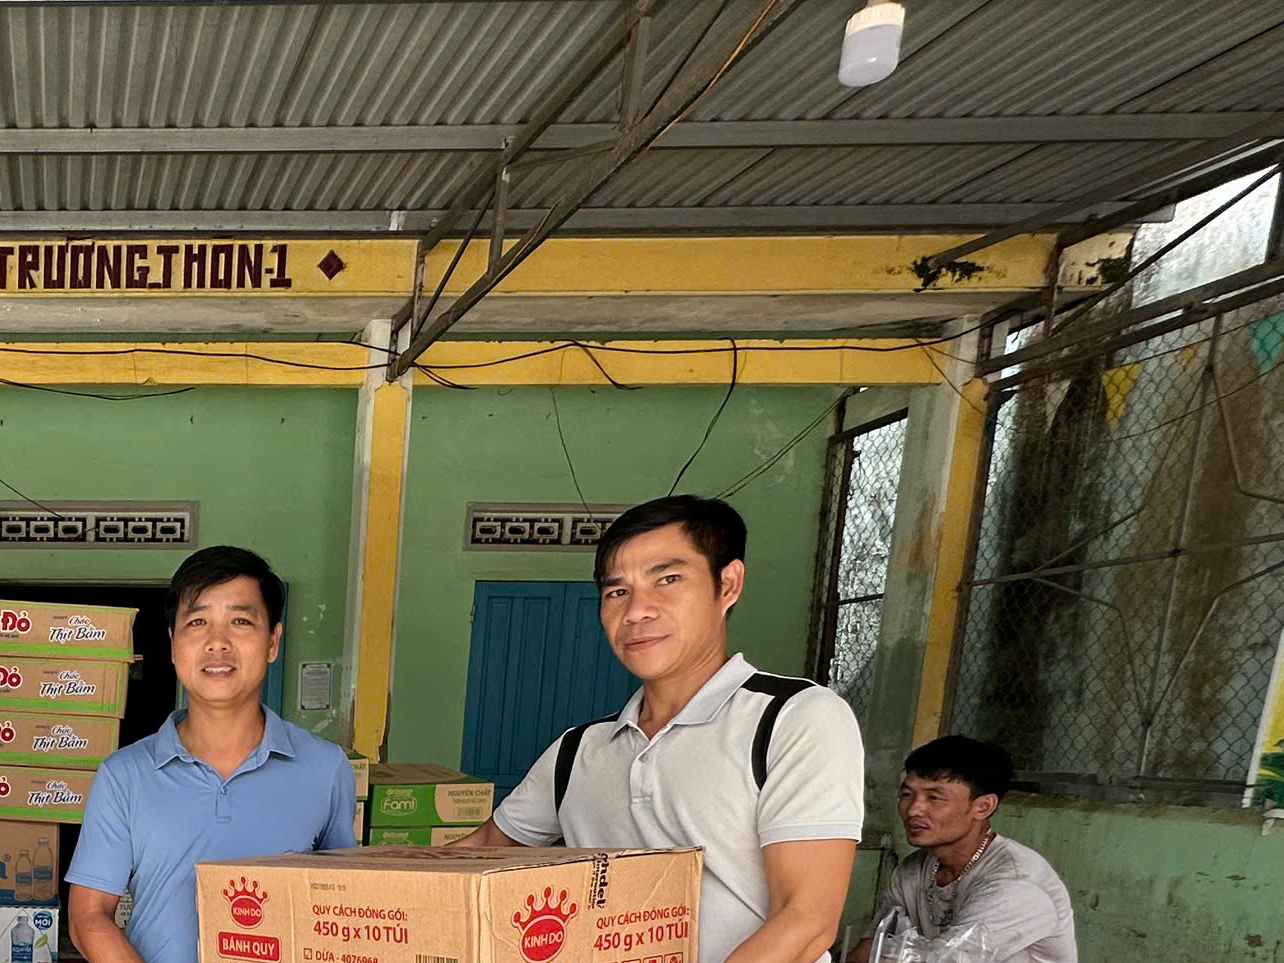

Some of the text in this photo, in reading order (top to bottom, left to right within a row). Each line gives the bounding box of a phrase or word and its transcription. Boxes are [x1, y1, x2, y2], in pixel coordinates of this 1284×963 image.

[1, 610, 31, 633] Đỏ
[312, 905, 331, 916] QUY
[333, 903, 356, 917] CÁCH
[358, 906, 385, 920] ĐÓNG
[596, 915, 616, 929] QUY
[617, 910, 641, 926] CÁCH
[642, 907, 669, 922] ĐÓNG
[314, 921, 408, 944] 450 g x 10 TÚI
[594, 921, 689, 951] 450 g x 10 TÚI
[222, 937, 275, 956] BÁNH QUY
[316, 948, 334, 962] DỪA
